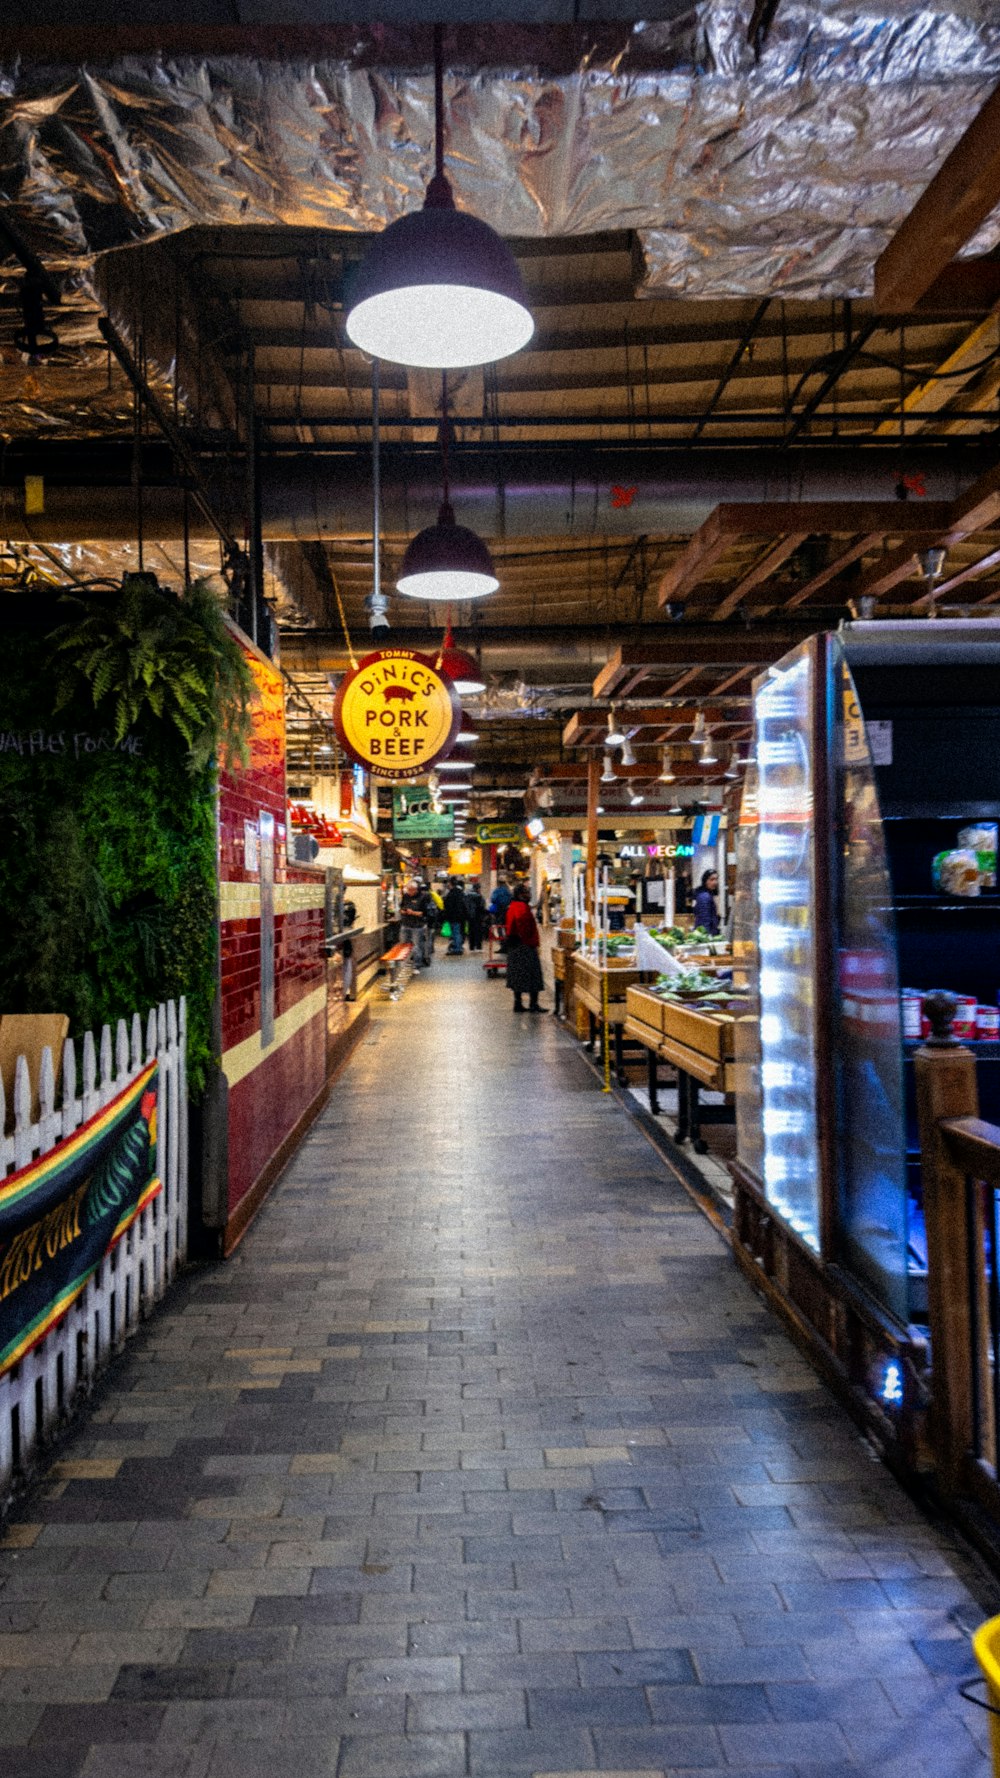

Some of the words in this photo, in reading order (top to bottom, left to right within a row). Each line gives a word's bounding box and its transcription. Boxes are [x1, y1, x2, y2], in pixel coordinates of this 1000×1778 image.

[380, 650, 416, 659] TOMMY
[366, 710, 428, 727] PORK
[393, 727, 401, 737] &
[370, 739, 425, 755] BEEF
[371, 766, 400, 777] SINCE
[620, 845, 646, 857] ALL
[647, 844, 695, 857] VEGAN
